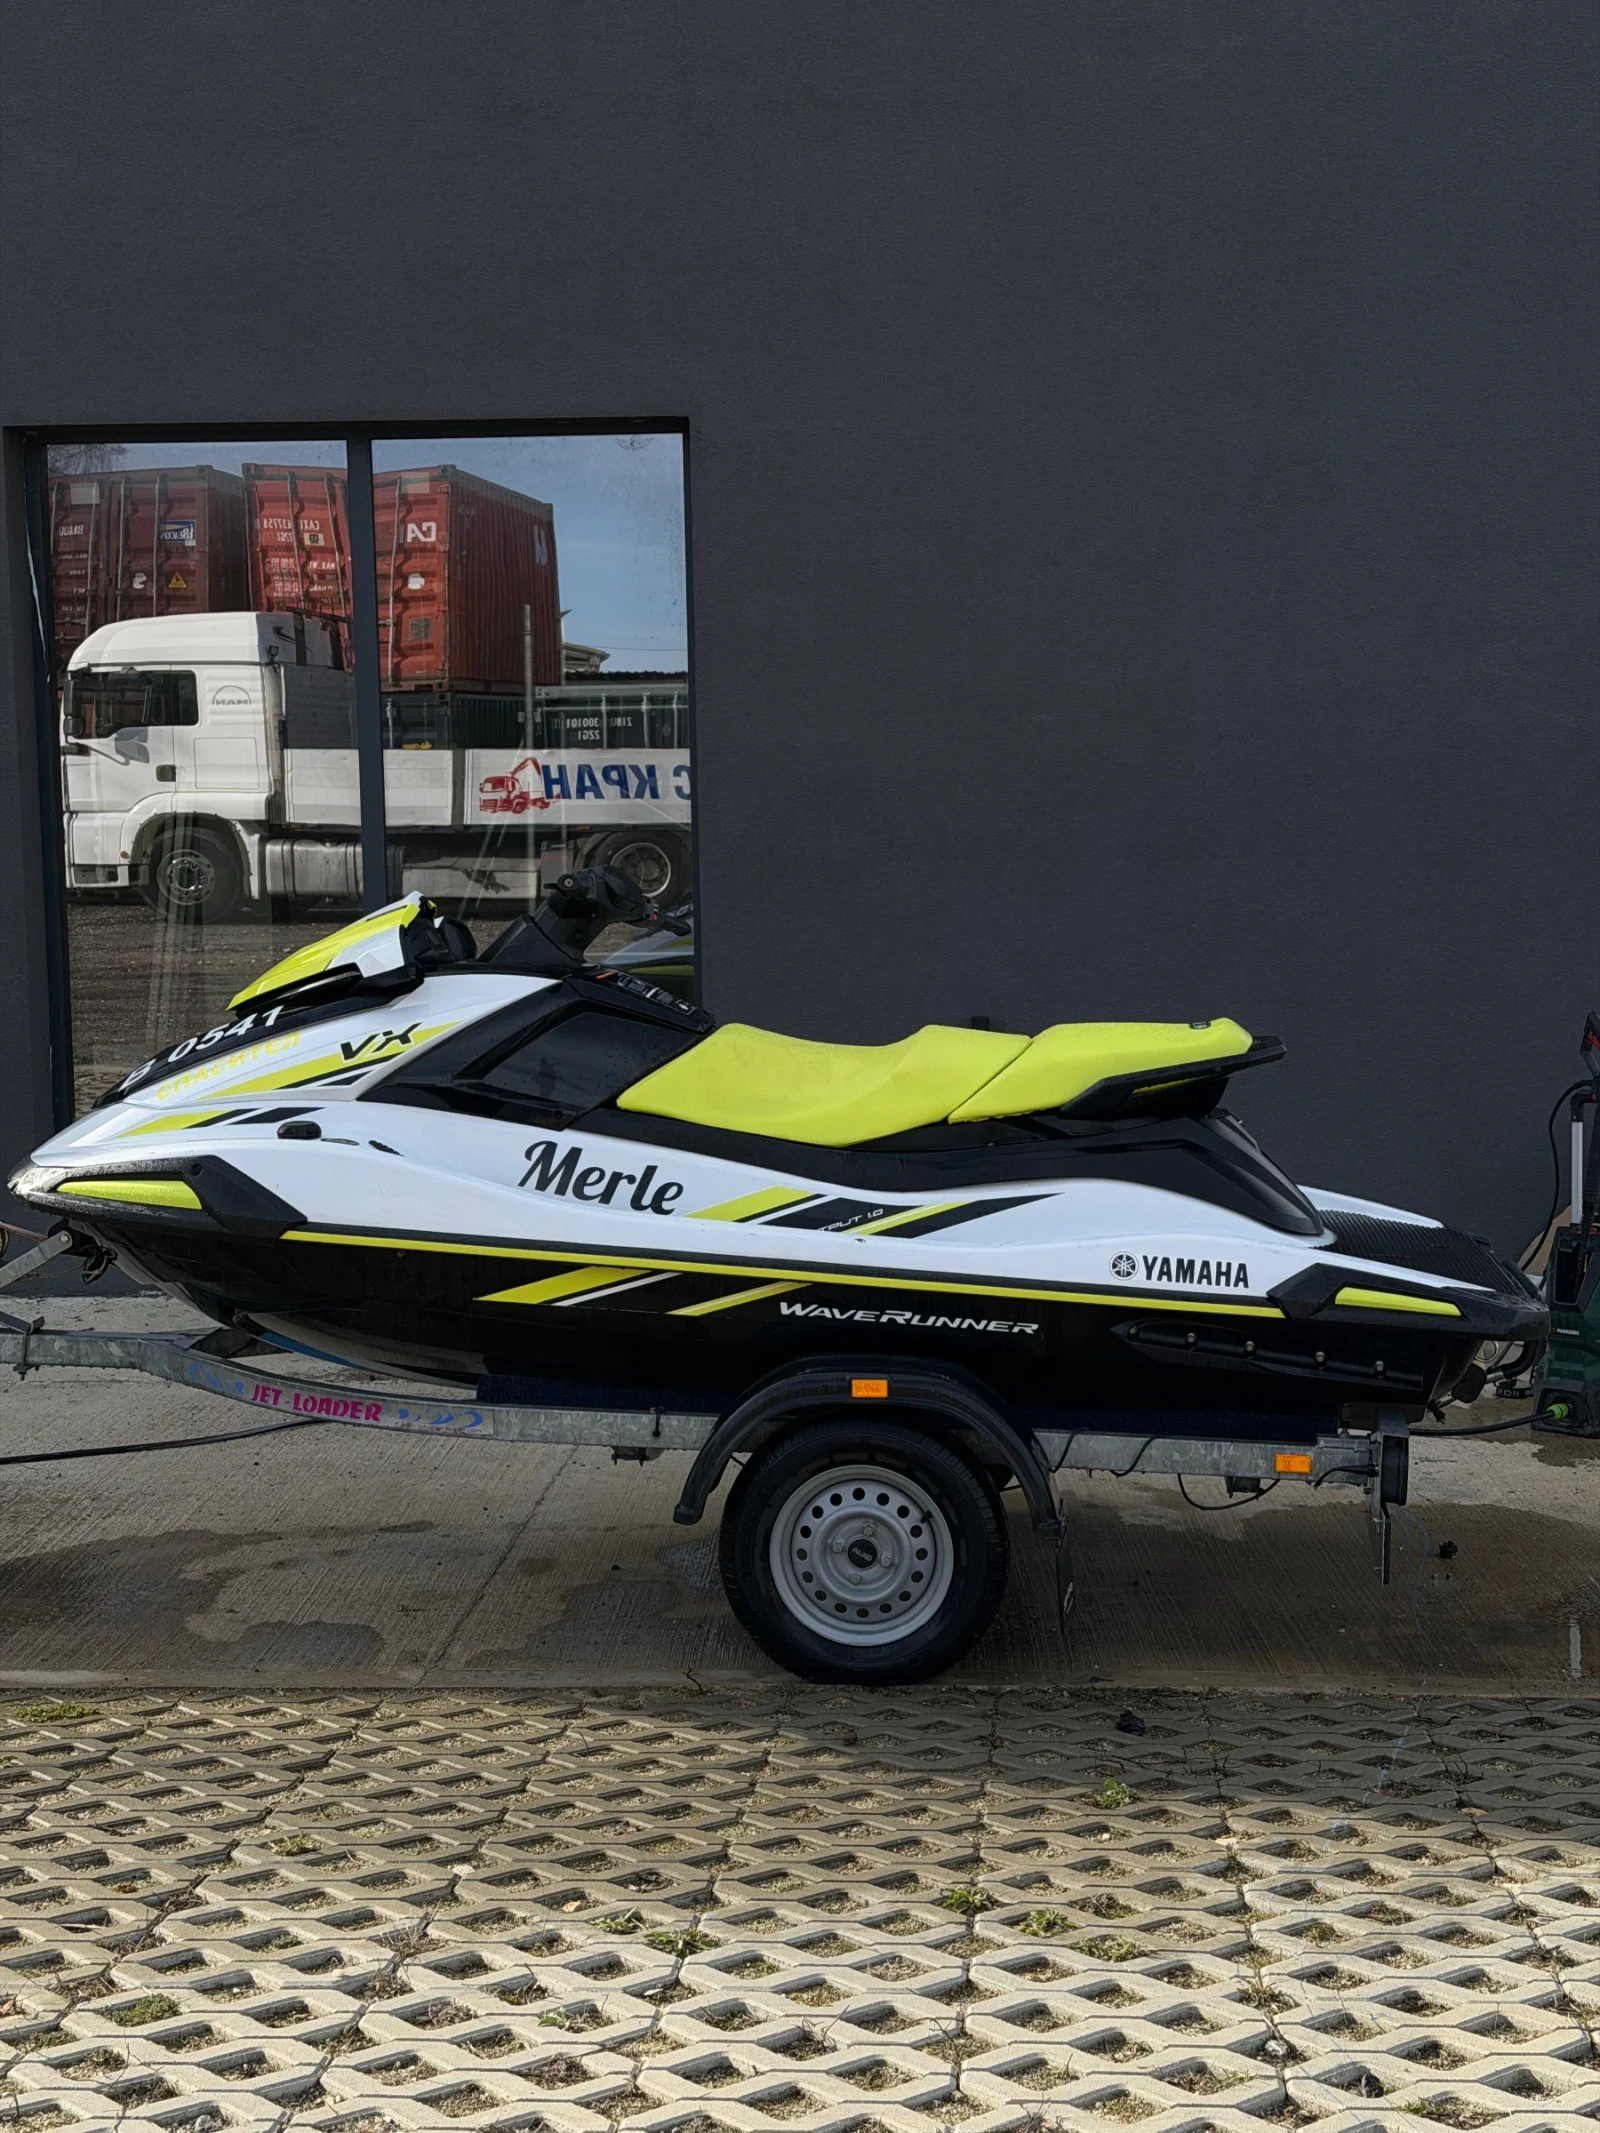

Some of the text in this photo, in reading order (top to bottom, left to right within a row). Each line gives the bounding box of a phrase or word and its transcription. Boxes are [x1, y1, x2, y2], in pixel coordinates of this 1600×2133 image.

[167, 1005, 285, 1063] 0541
[340, 1021, 423, 1061] VX
[517, 1140, 684, 1215] Merle
[867, 1208, 884, 1219] 1.0
[1142, 1255, 1249, 1288] YAMAHA
